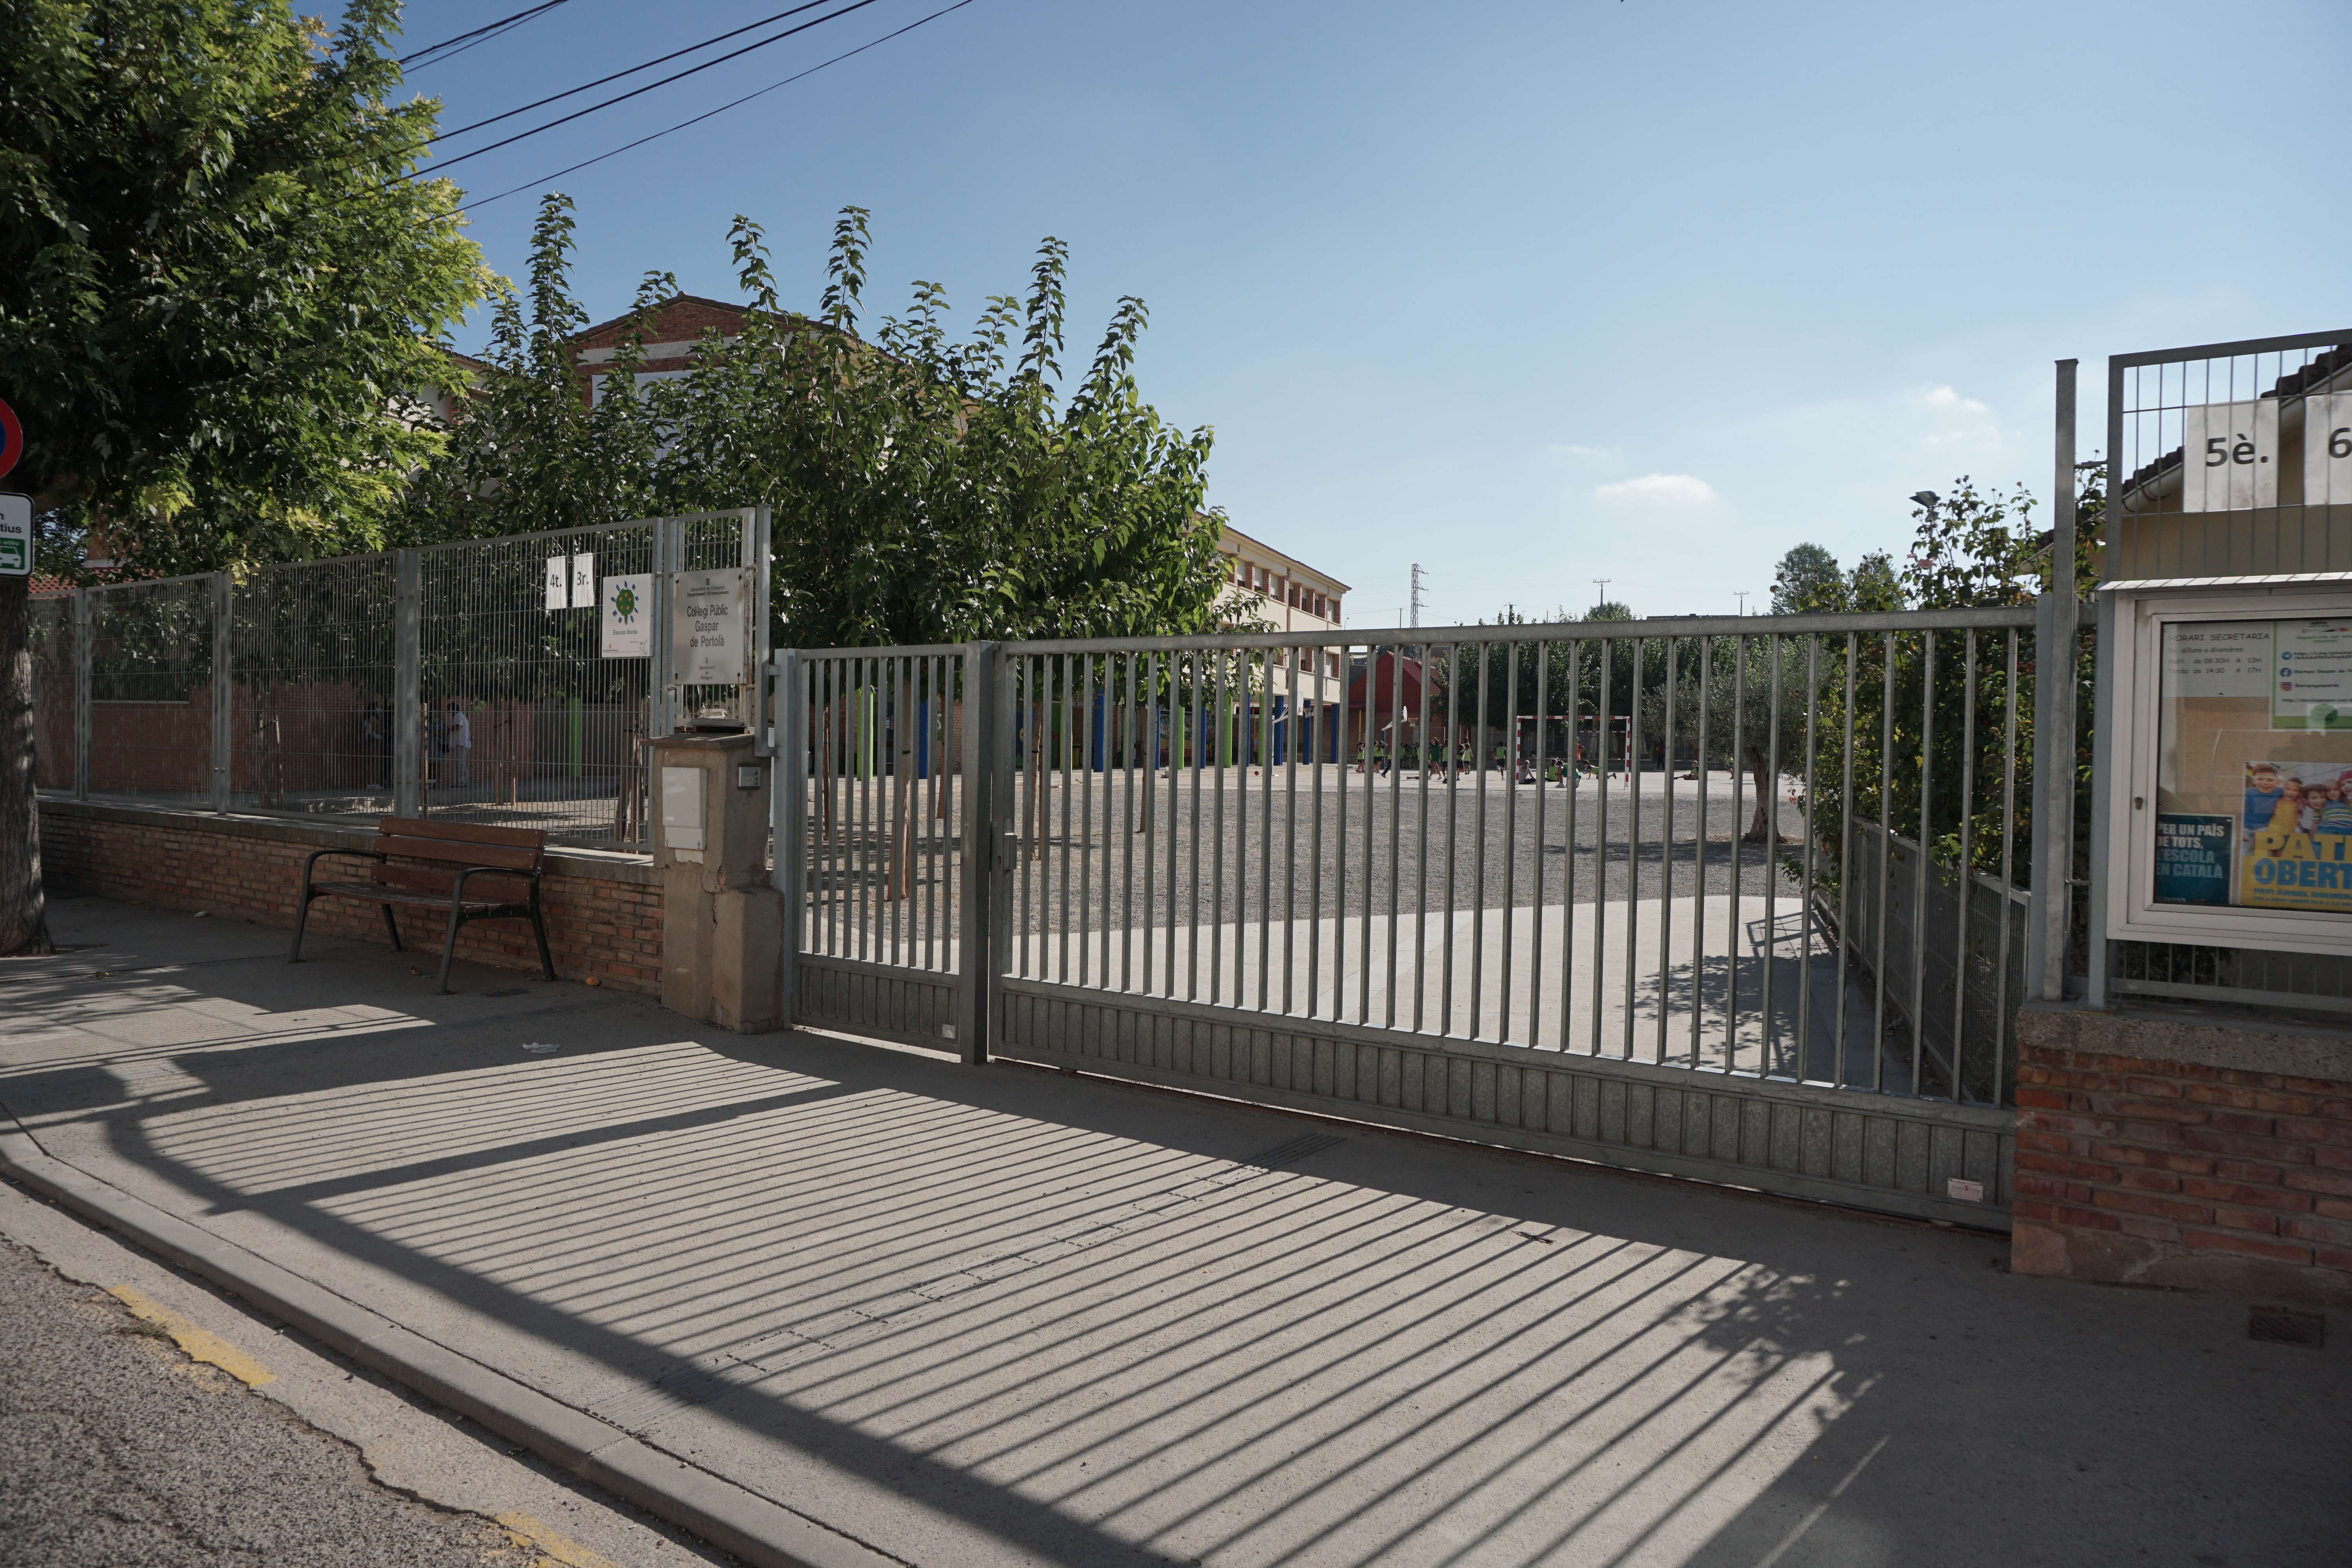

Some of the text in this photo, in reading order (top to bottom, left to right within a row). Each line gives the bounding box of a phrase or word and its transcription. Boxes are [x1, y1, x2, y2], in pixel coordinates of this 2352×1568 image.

[2206, 434, 2269, 466] 5è.
[2328, 427, 2352, 459] 6
[550, 574, 561, 588] 4t.
[577, 572, 589, 586] 3r.
[710, 604, 728, 616] Públic
[695, 620, 719, 633] Gaspar
[690, 635, 724, 647] de Portolà
[2157, 823, 2225, 837] PER UN PAÍS
[2157, 836, 2204, 849] DE TOTS.
[2156, 863, 2223, 878] EN CATALÀ
